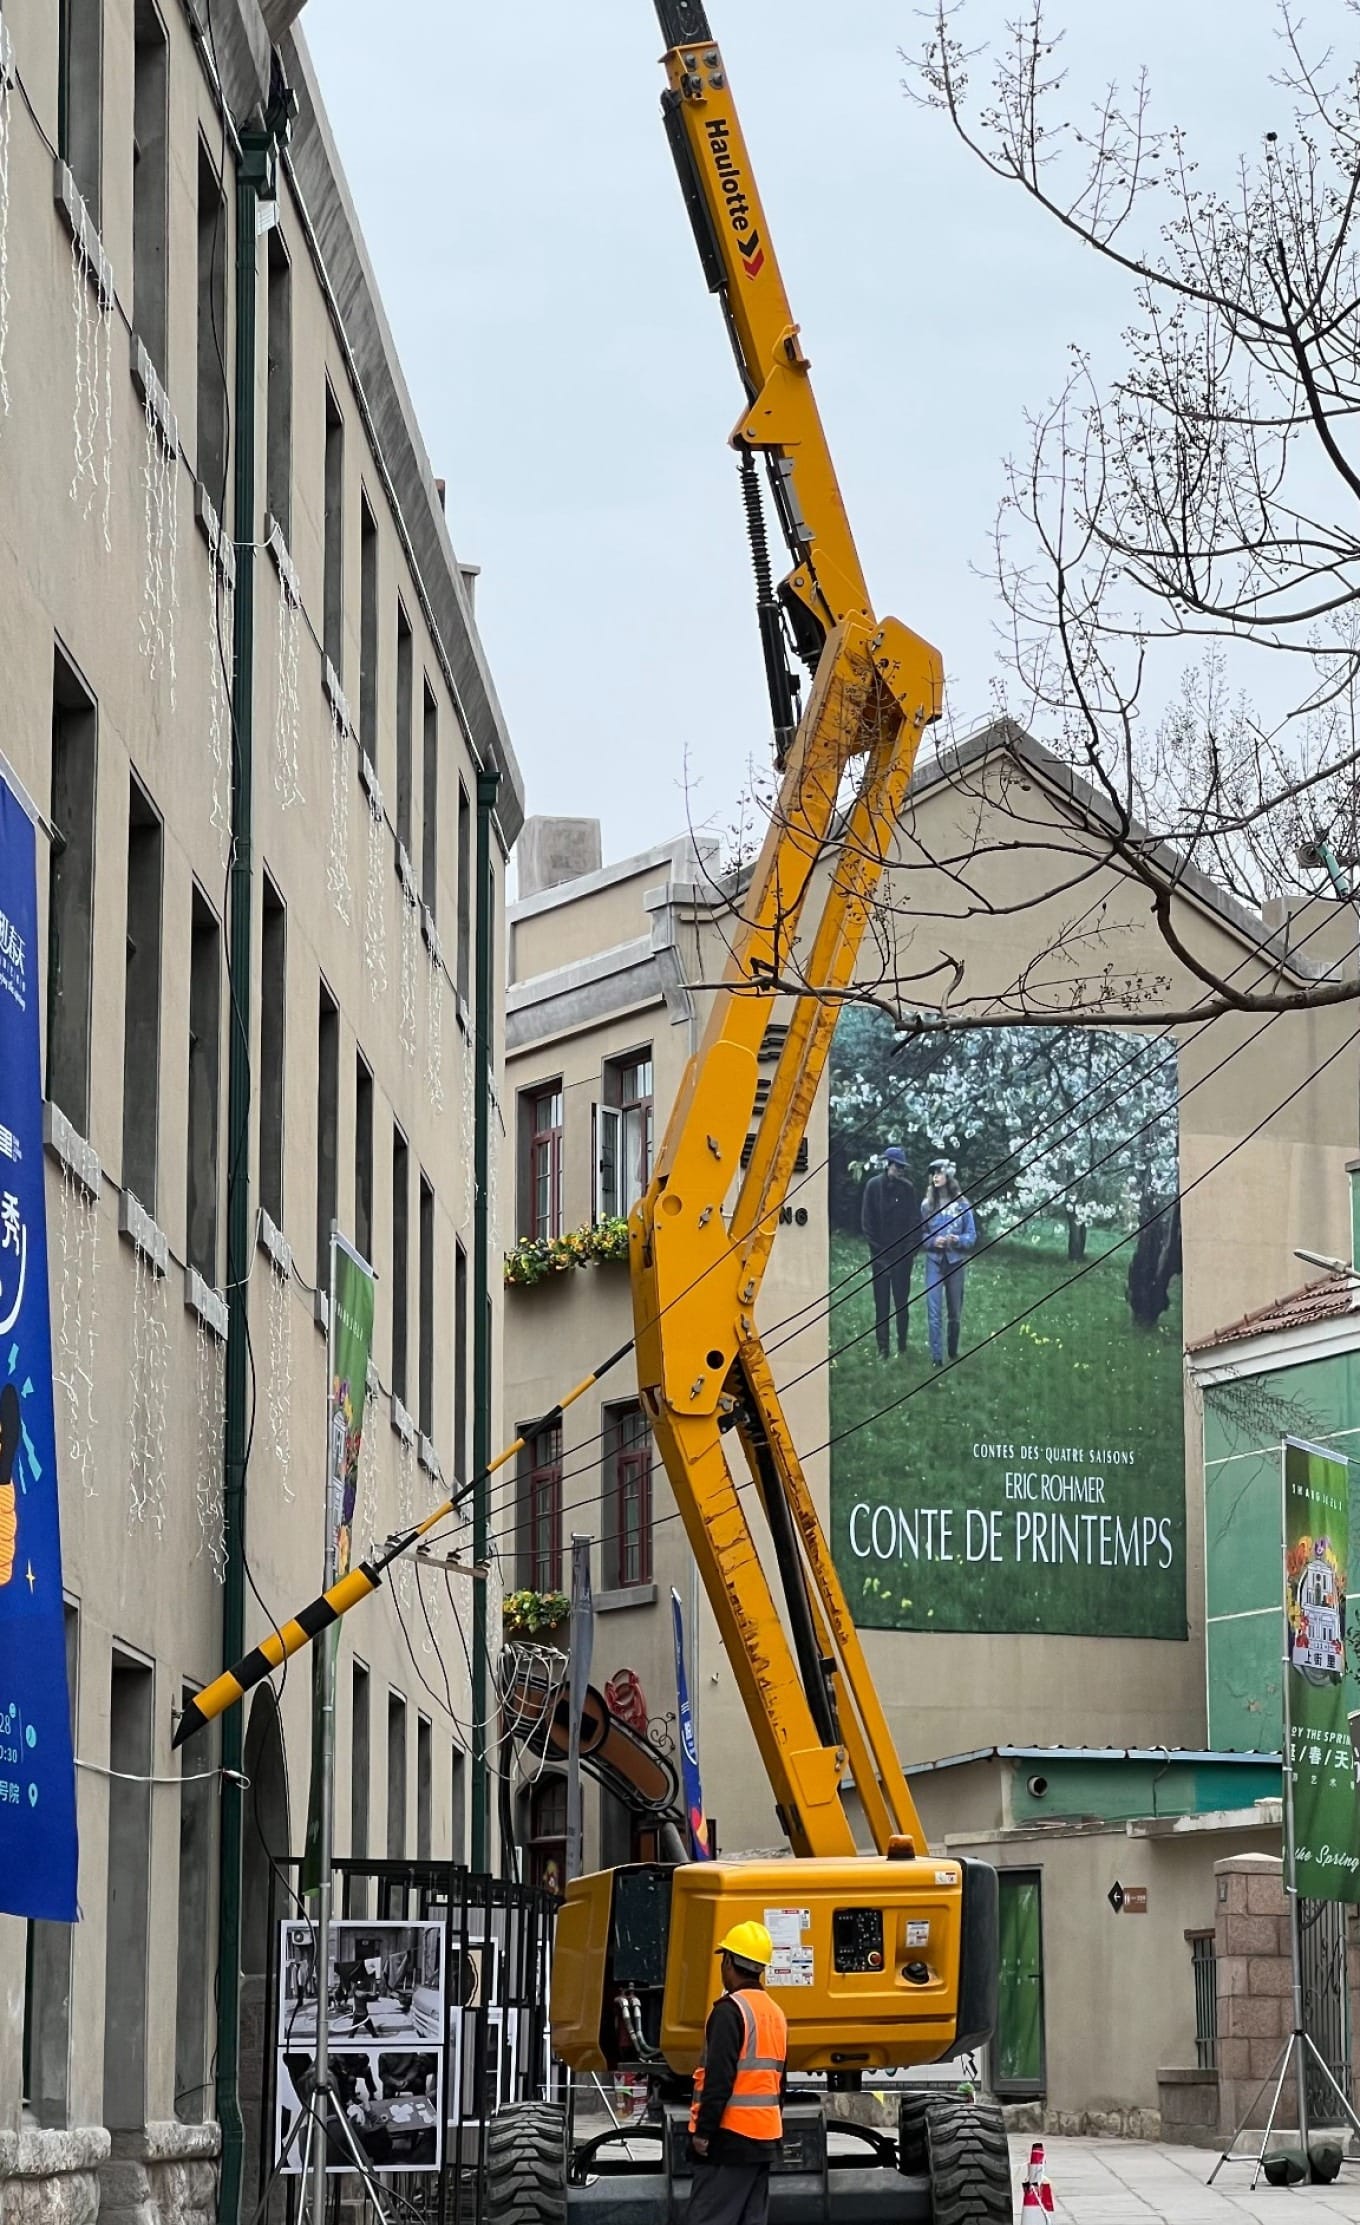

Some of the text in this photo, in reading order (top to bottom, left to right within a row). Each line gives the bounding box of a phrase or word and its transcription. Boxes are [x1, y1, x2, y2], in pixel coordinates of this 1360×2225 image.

[705, 118, 749, 231] Haulotte
[973, 1443, 1135, 1465] CONTES DES QUATRE SAISONS
[1005, 1471, 1106, 1504] ERIC ROHMER
[849, 1502, 1173, 1569] CONTE DE PRINTEMPS
[1306, 1728, 1322, 1741] THE
[1315, 1844, 1360, 1873] Spring
